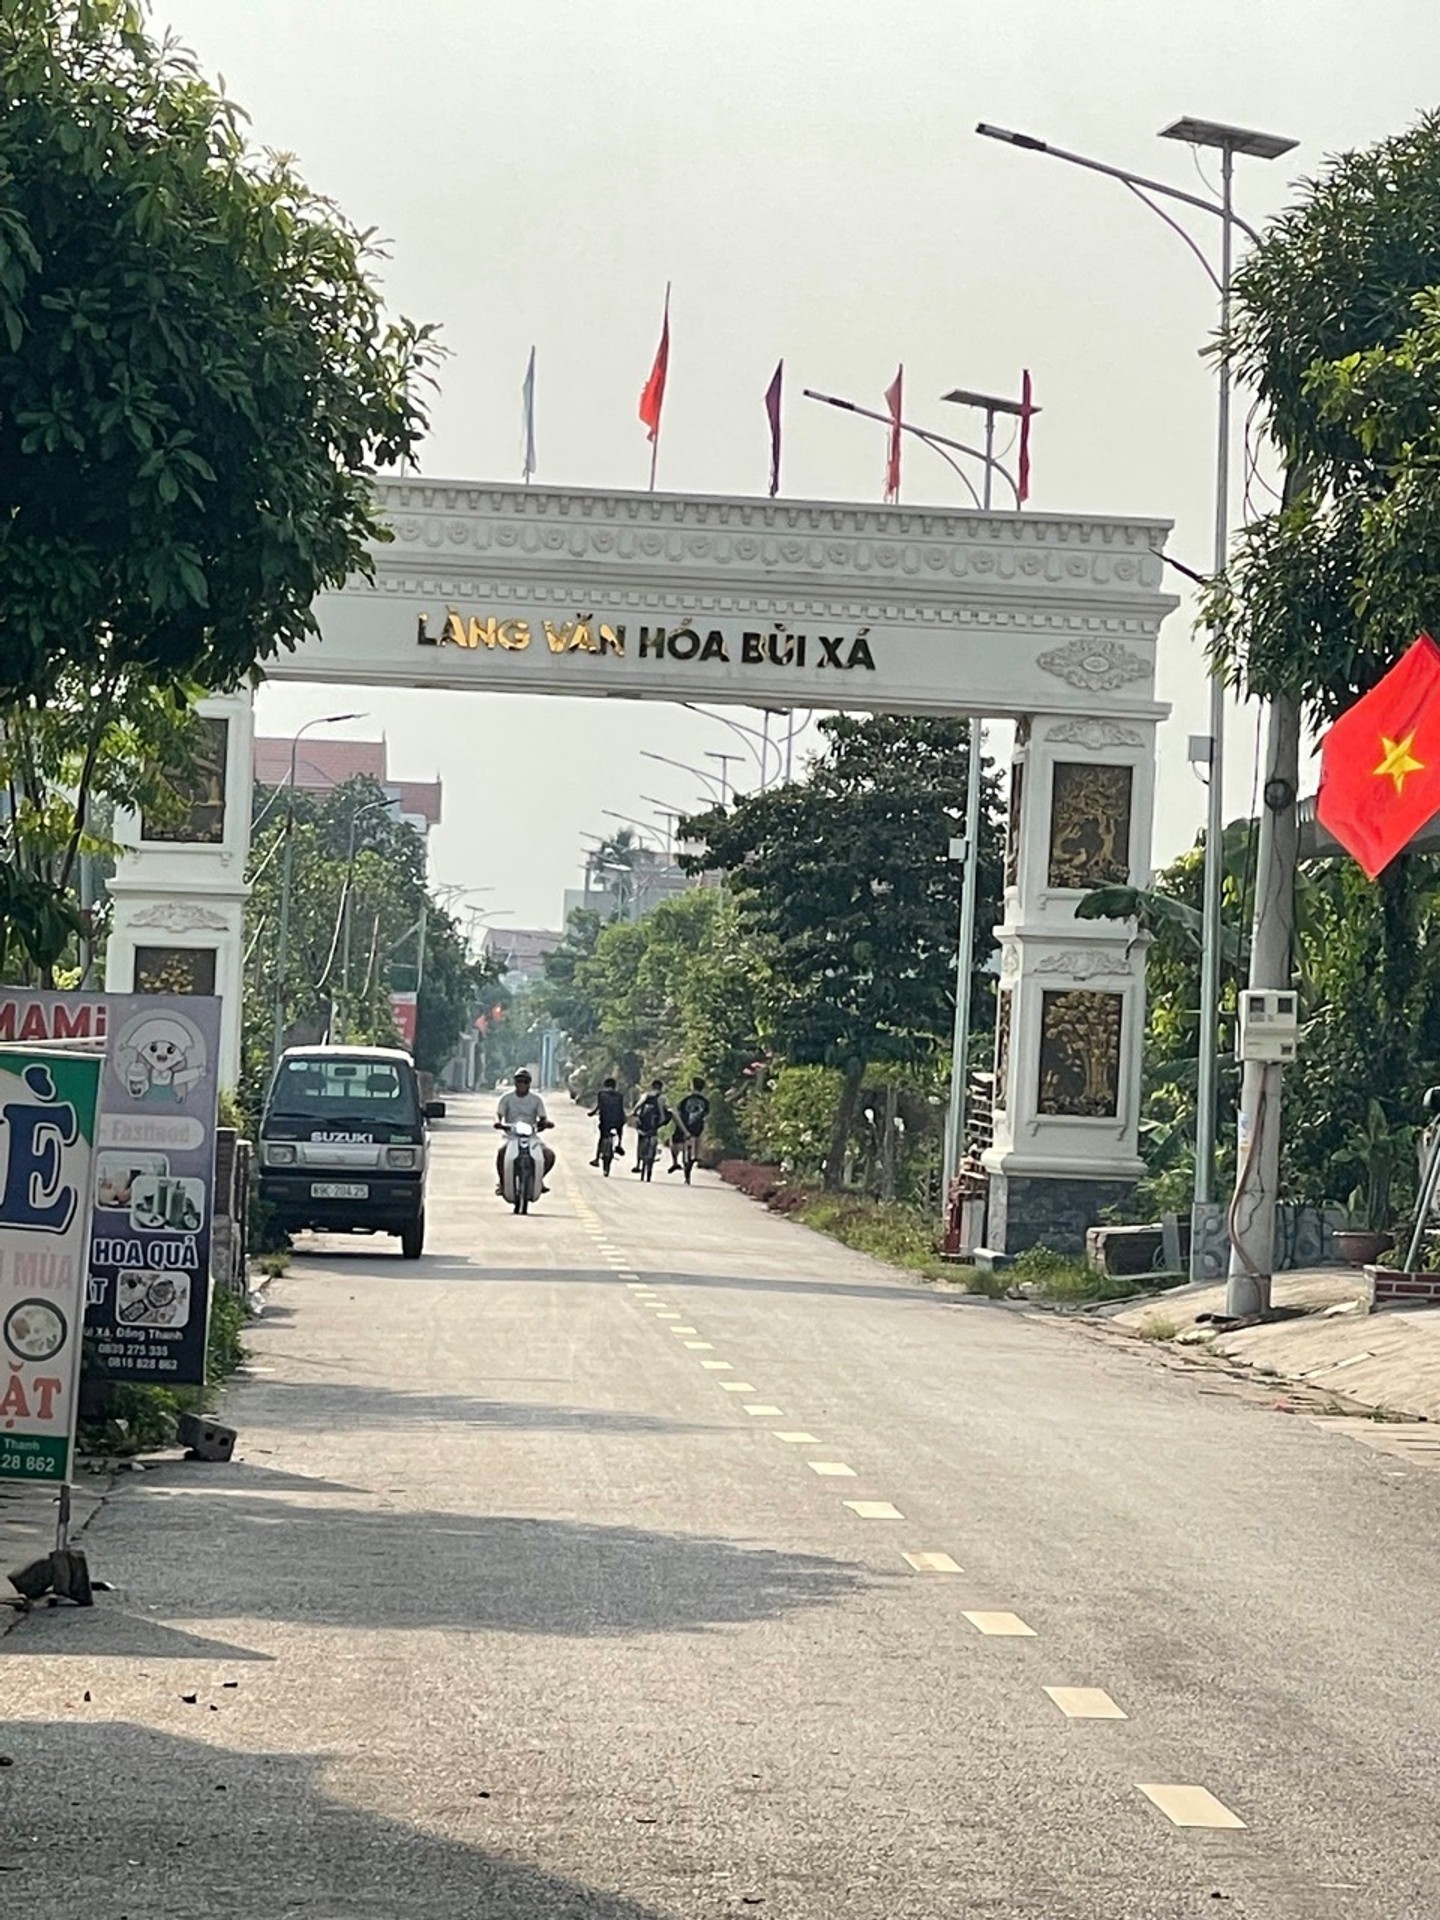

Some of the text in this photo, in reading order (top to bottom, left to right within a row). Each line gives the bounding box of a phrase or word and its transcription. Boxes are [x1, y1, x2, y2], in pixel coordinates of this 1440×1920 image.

[417, 604, 876, 671] LÀNG VĂN HÓA BÙI XÁ
[0, 1062, 77, 1234] È
[310, 1130, 374, 1144] SUZUKI
[92, 1234, 199, 1271] HOA QUẢ
[26, 1455, 56, 1473] 862
